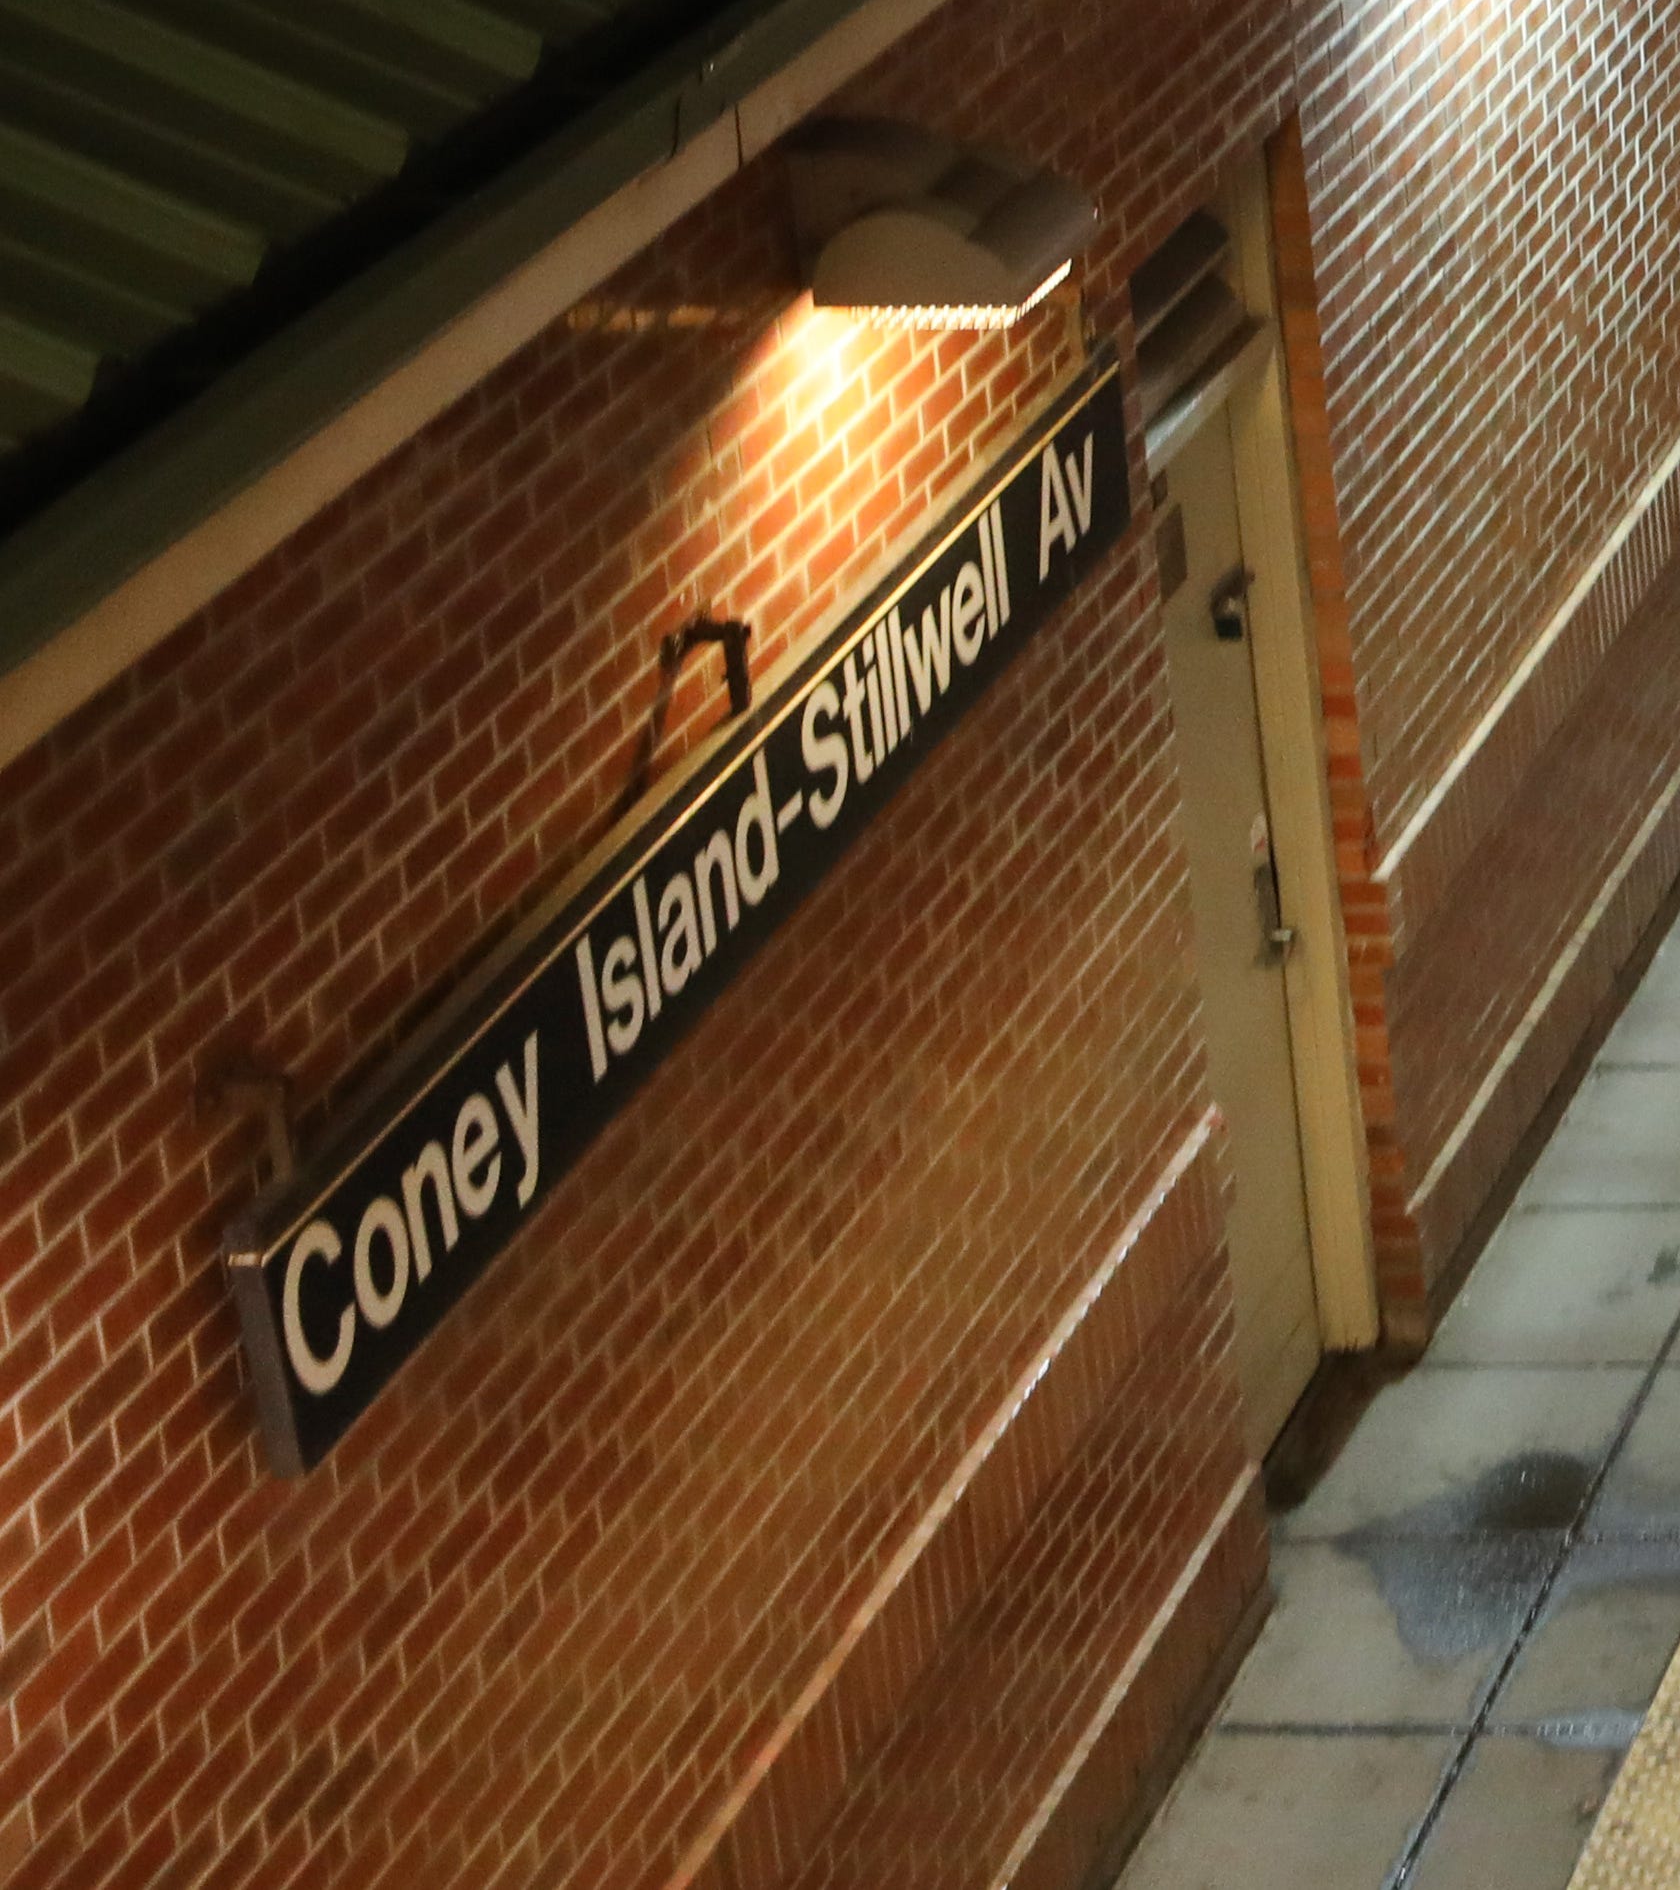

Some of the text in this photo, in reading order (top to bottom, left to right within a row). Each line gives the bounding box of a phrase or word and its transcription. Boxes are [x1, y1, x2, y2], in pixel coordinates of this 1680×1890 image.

[282, 432, 1098, 1398] Coney Island-Stillwell Av
